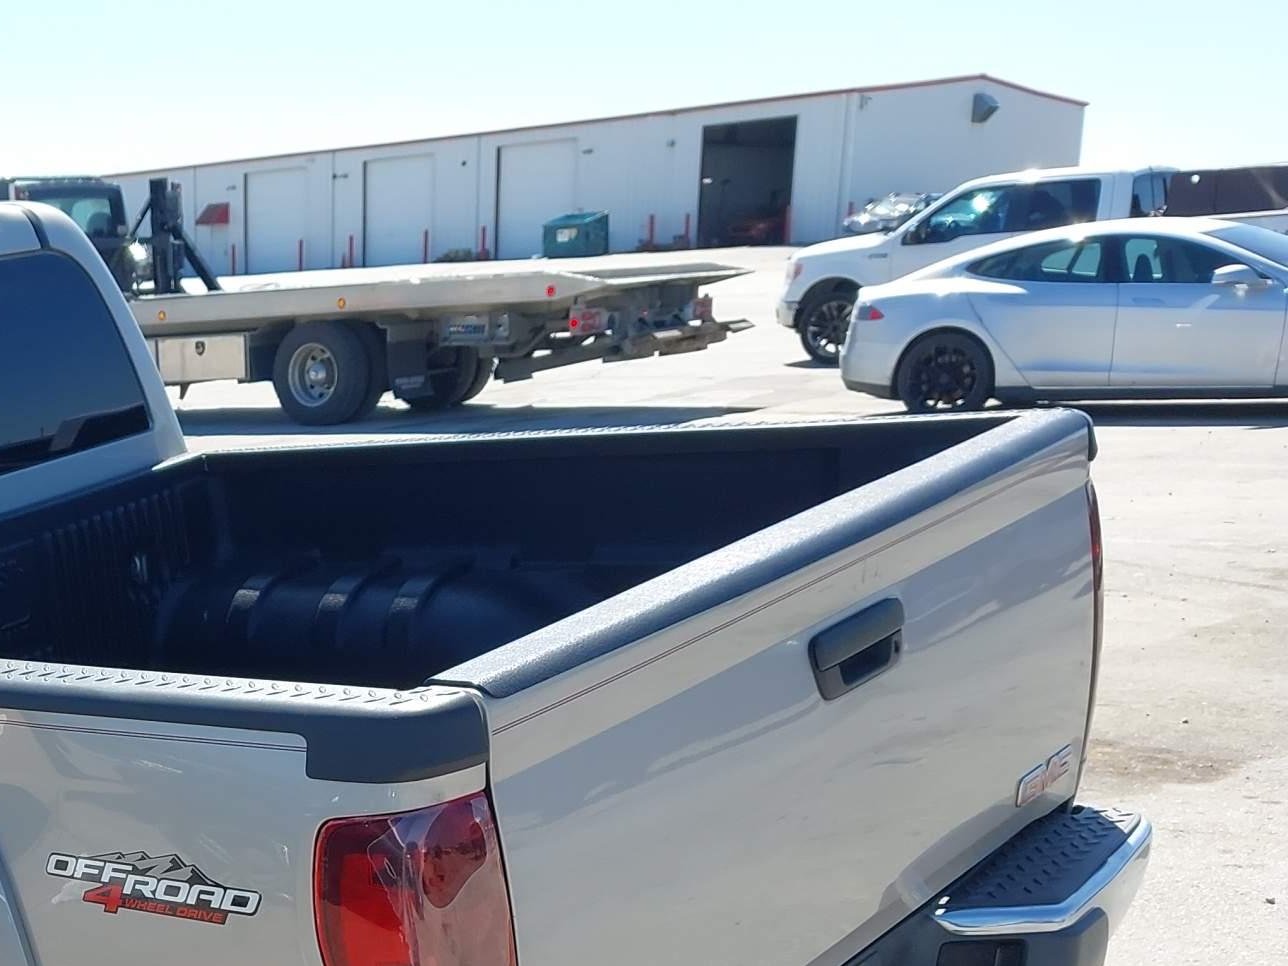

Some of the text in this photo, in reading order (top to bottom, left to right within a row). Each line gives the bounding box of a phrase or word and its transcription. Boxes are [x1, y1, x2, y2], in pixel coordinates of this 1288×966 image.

[46, 853, 262, 914] OFF ROAD
[83, 884, 226, 923] 4 WHEEL DRIVE
